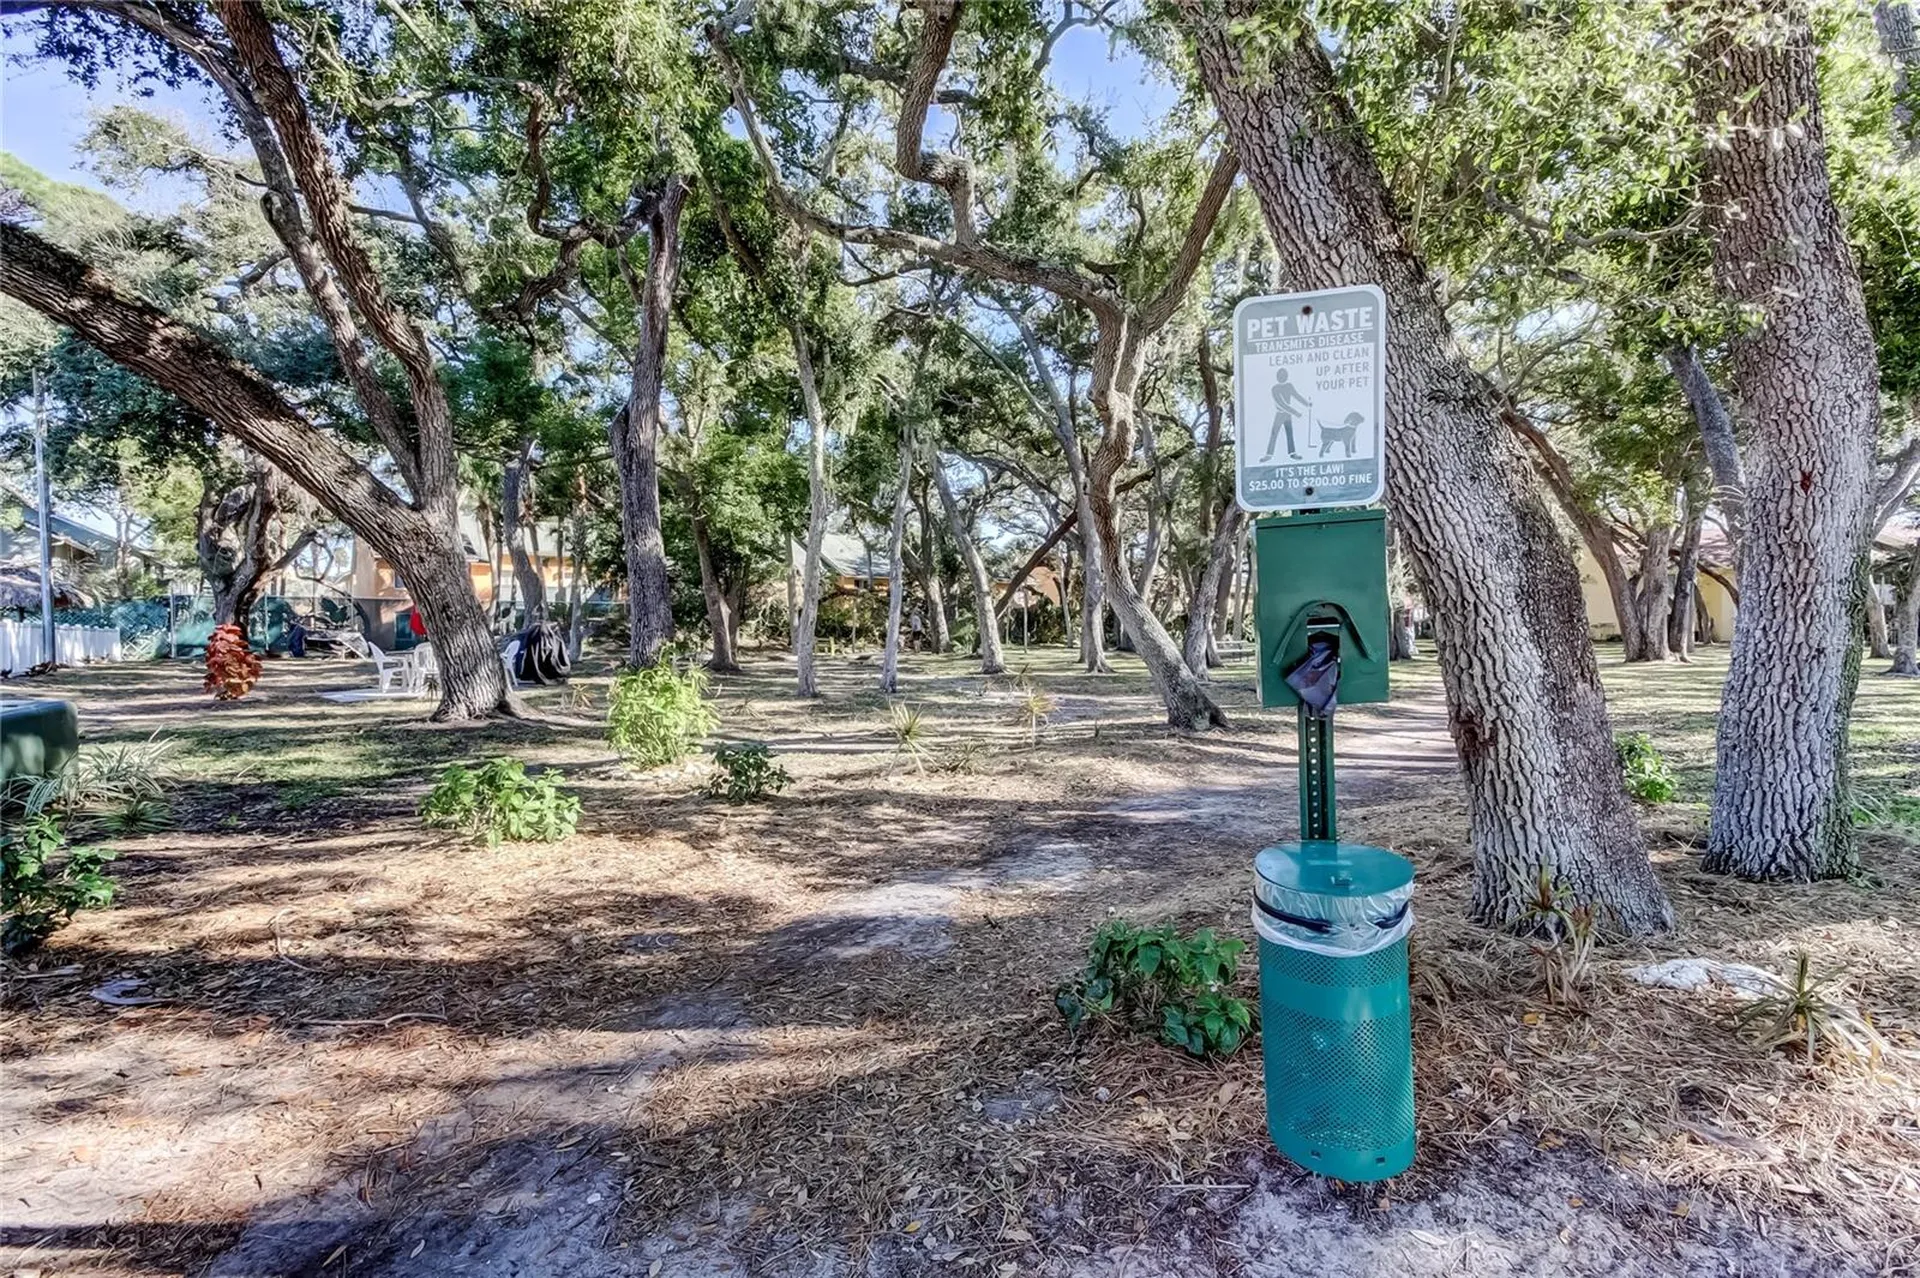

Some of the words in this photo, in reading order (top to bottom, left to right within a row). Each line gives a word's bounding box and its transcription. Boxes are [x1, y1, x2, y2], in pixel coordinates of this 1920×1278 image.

[1247, 316, 1288, 339] PET
[1296, 307, 1373, 334] WASTE
[1255, 337, 1315, 353] TRANSMITS
[1318, 332, 1364, 347] DISEASE
[1269, 354, 1303, 367] LEASH
[1307, 351, 1329, 363] AND
[1333, 347, 1369, 360] CLEAN
[1316, 365, 1331, 377] UP
[1334, 361, 1369, 375] AFTER
[1316, 379, 1345, 391] YOUR
[1348, 376, 1369, 388] PET
[1275, 466, 1294, 478] IT'S
[1298, 465, 1316, 476] THE
[1319, 464, 1344, 475] LAW!
[1249, 480, 1284, 492] $25.00
[1287, 478, 1299, 489] TO
[1302, 475, 1346, 488] $200.00
[1349, 473, 1373, 484] FINE
